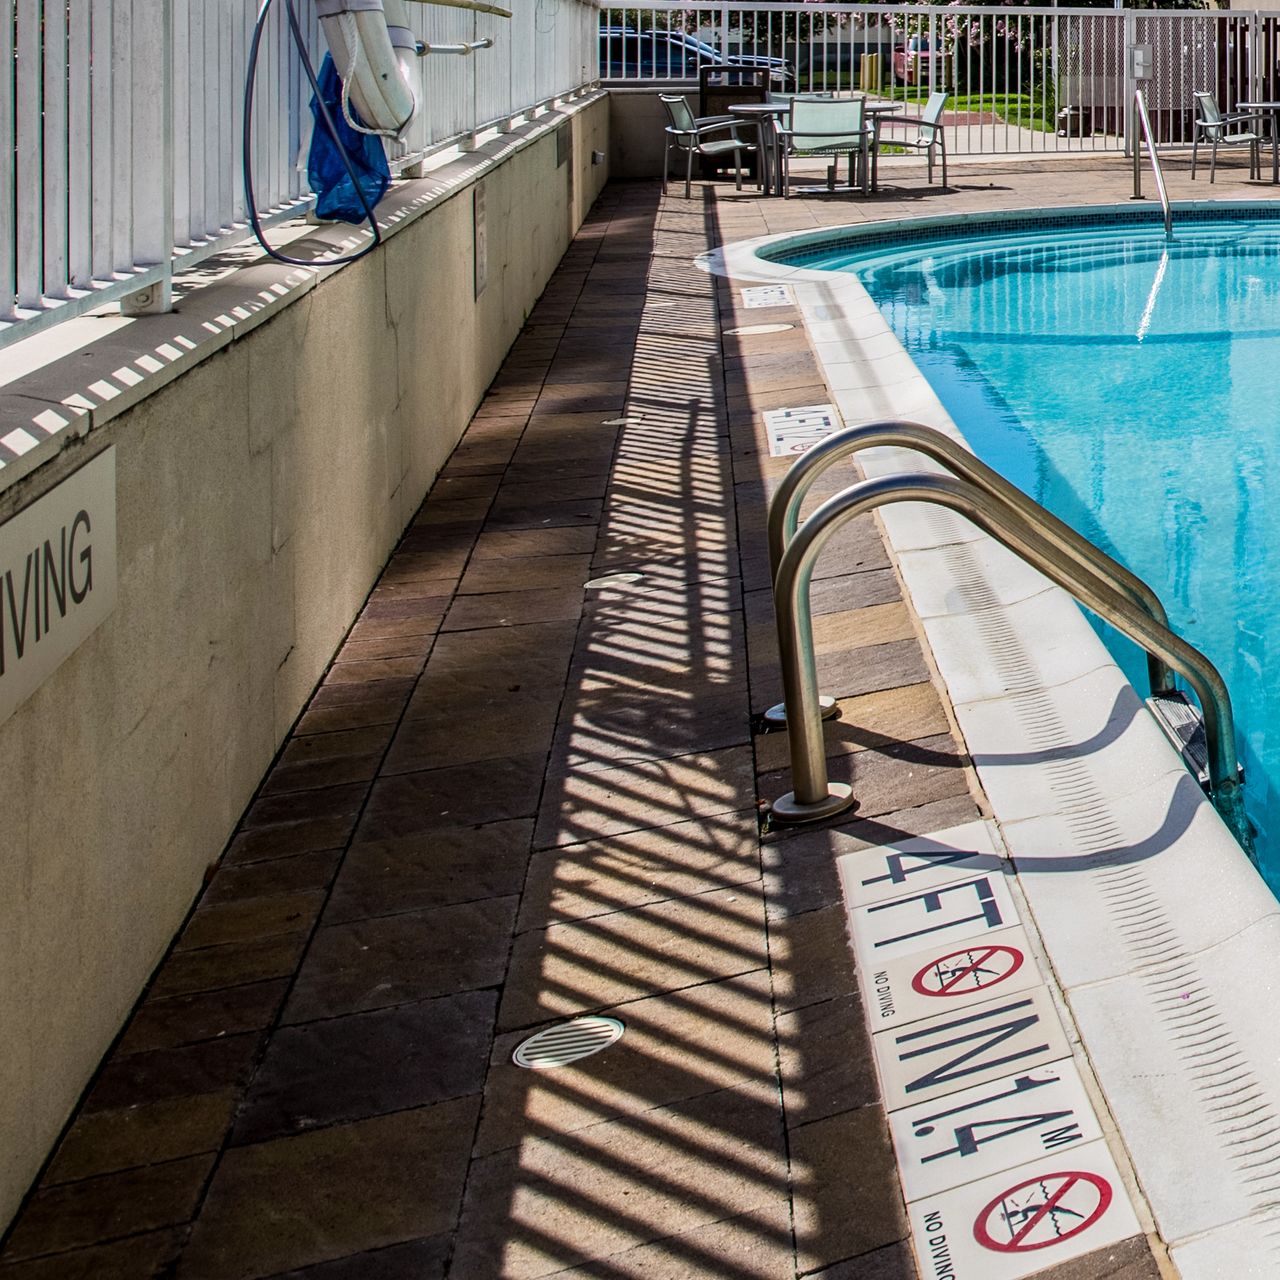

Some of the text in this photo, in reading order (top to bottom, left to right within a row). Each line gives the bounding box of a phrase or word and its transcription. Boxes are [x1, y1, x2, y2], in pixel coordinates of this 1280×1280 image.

[862, 851, 980, 886] 4
[867, 876, 1004, 948] FT
[873, 970, 896, 1018] NO DIVING
[896, 998, 1050, 1094] IN
[923, 1210, 944, 1233] NO
